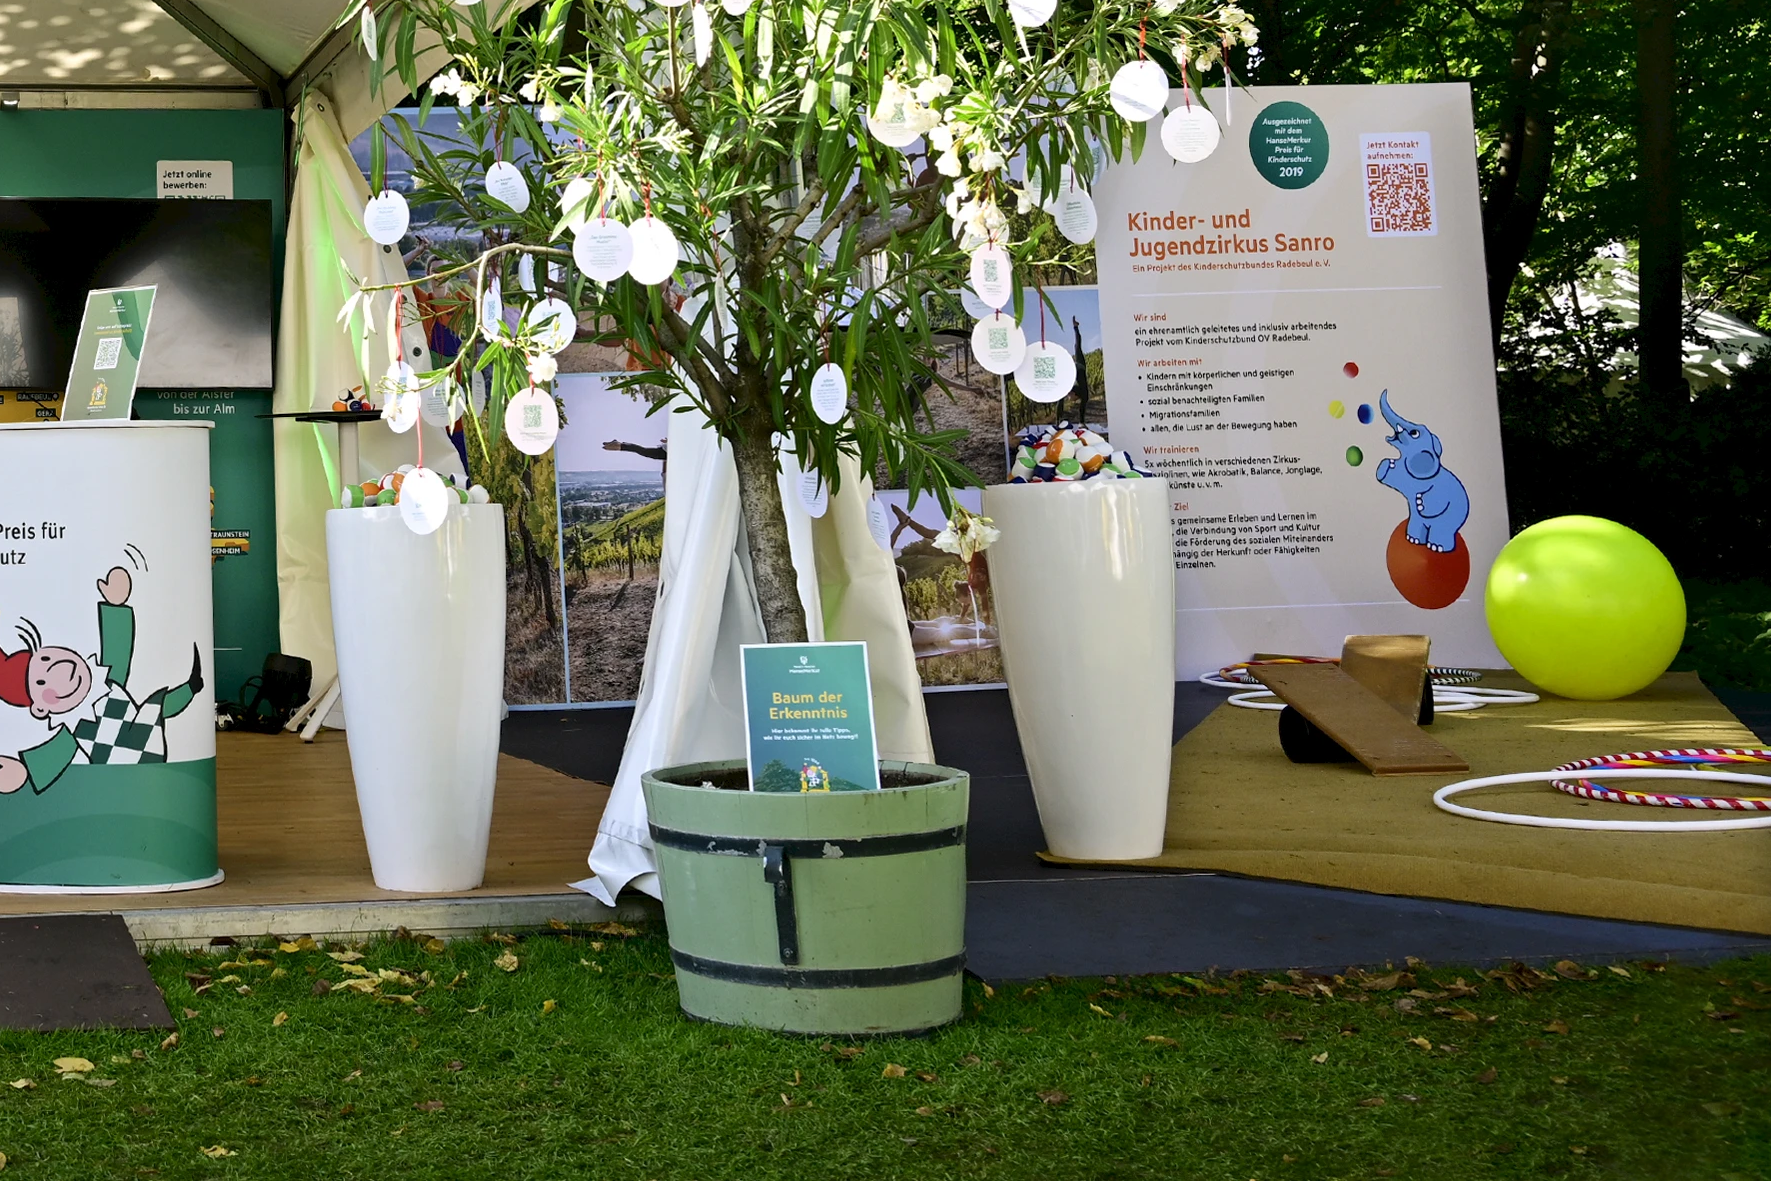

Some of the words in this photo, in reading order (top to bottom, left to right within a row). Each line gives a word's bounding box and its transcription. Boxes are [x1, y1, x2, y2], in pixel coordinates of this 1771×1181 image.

[1262, 117, 1312, 127] Ausgezeichnet
[1275, 127, 1286, 135] mit
[1288, 127, 1302, 135] dem
[1266, 137, 1311, 145] HanseMerkur
[1366, 141, 1386, 150] Jetzt
[1388, 140, 1419, 148] Kontakt
[1294, 145, 1304, 153] für
[1267, 155, 1312, 164] Kinderschutz
[1367, 151, 1414, 160] aufnehmen:
[163, 170, 184, 179] Jetzt
[186, 170, 212, 178] online
[1279, 167, 1304, 178] 2019
[163, 181, 207, 190] bewerben:
[1128, 211, 1205, 231] Kinder-
[1212, 208, 1251, 229] und
[1129, 236, 1269, 261] Jugendzirkus
[1275, 233, 1335, 252] Sanro
[1132, 265, 1145, 273] Ein
[1147, 263, 1177, 273] Projekt
[1179, 263, 1191, 271] des
[1194, 260, 1275, 270] Kinderschutzbundes
[1277, 259, 1313, 268] Radebeul
[1151, 313, 1167, 321] sind
[1135, 327, 1146, 335] ein
[1149, 325, 1200, 334] ehrenamtlich
[1202, 323, 1240, 334] geleitetes
[1242, 323, 1257, 332] und
[1259, 323, 1288, 331] inklusiv
[1291, 322, 1337, 331] arbeitendes
[1136, 337, 1163, 347] Projekt
[1185, 334, 1256, 344] Kinderschutzbund
[1258, 334, 1270, 342] OV
[1272, 333, 1310, 342] Radebeul.
[1137, 359, 1151, 367] Wir
[1153, 358, 1187, 367] arbeiten
[1189, 358, 1202, 366] mit
[1147, 382, 1213, 393] Einschränkungen
[174, 404, 189, 414] bis
[193, 406, 210, 414] zur
[214, 404, 235, 414] Alm
[41, 522, 66, 539] für
[772, 692, 814, 704] Baum
[819, 691, 842, 702] der
[770, 707, 847, 719] Erkenntnis
